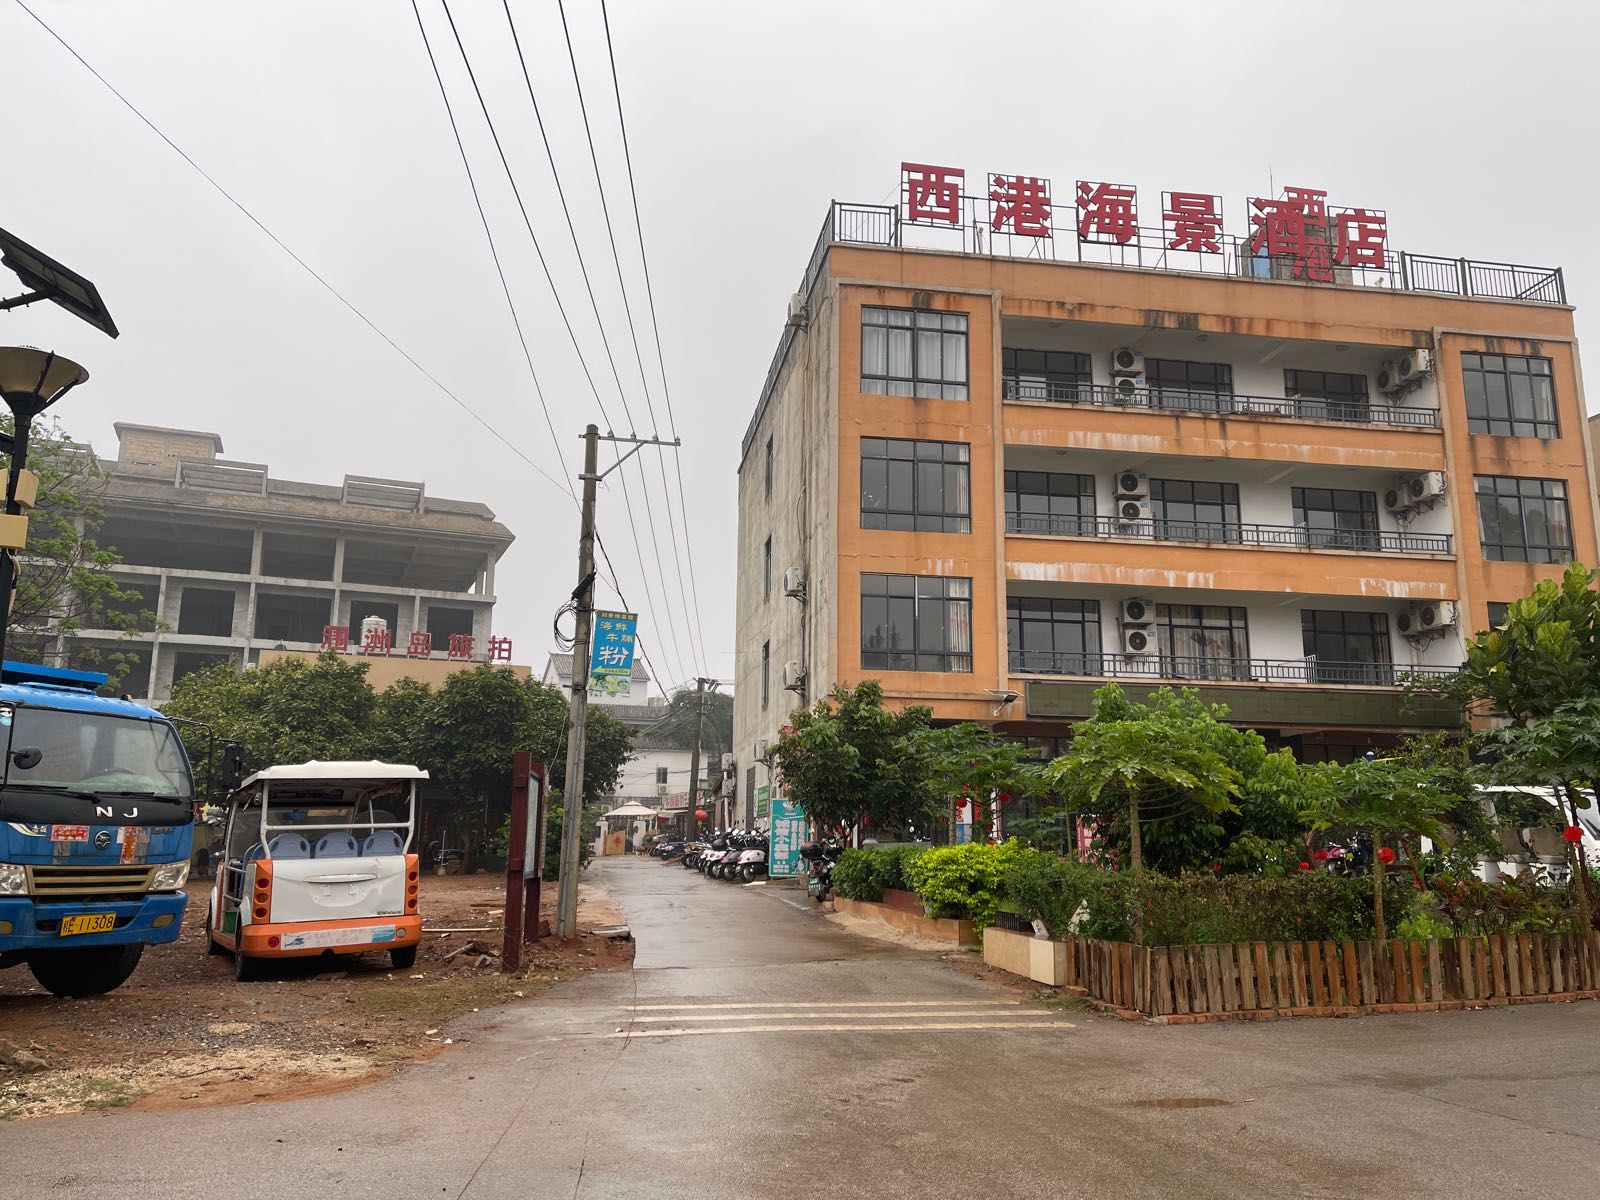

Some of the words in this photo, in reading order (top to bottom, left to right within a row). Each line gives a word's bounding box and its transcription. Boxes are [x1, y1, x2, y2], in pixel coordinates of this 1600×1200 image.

[901, 161, 1386, 269] 西港海景酒店
[598, 645, 629, 667] 粉
